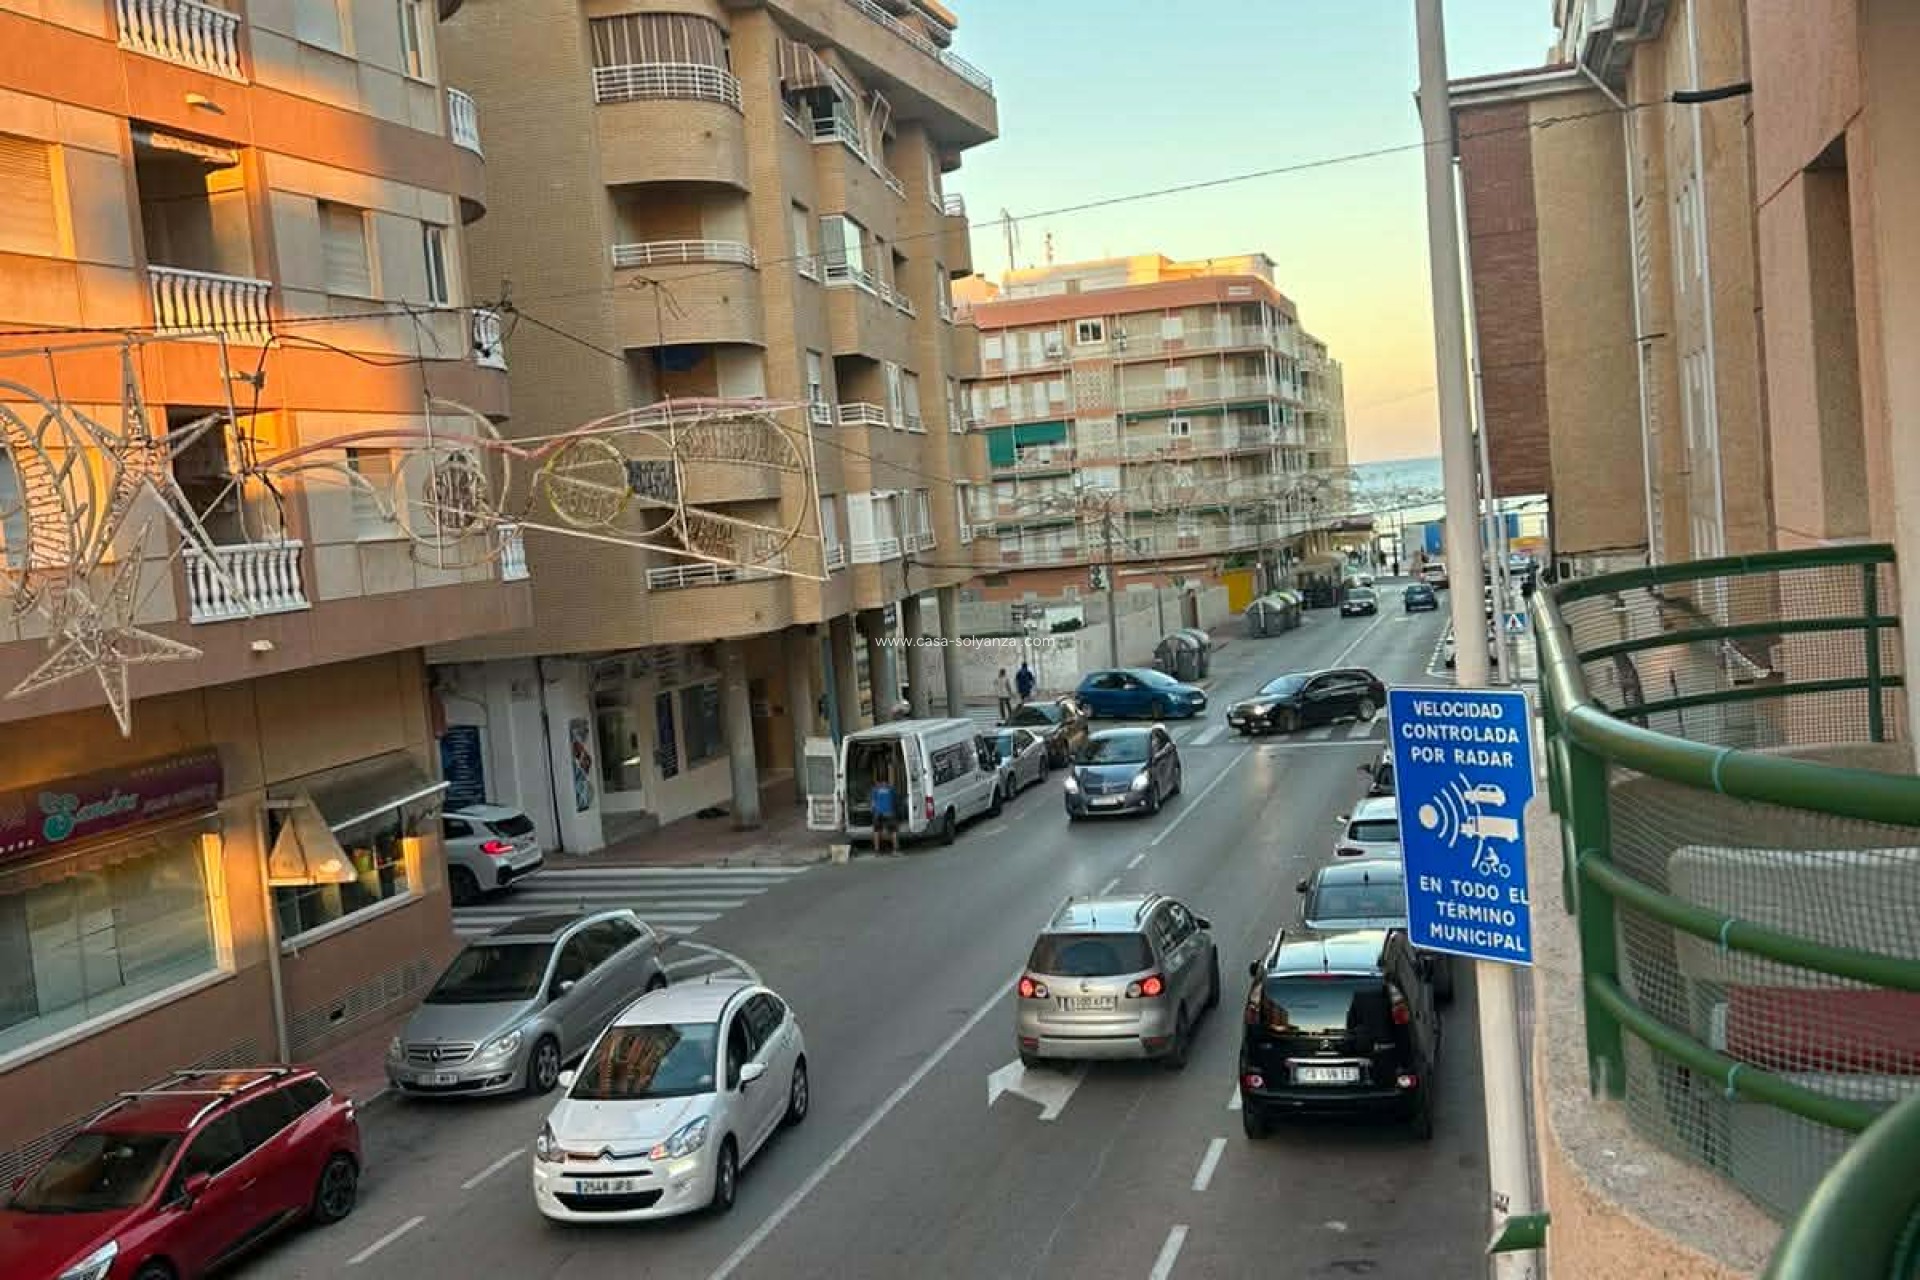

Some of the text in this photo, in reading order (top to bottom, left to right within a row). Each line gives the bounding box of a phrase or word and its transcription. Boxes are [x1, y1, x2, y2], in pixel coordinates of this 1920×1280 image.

[1413, 700, 1503, 718] VELOCIDAD
[1402, 722, 1519, 744] CONTROLADA
[1411, 746, 1513, 768] POR RADAR
[1420, 875, 1530, 905] EN TODO EL
[1436, 899, 1516, 927] TÉRMINO
[1430, 922, 1526, 952] MUNICIPAL
